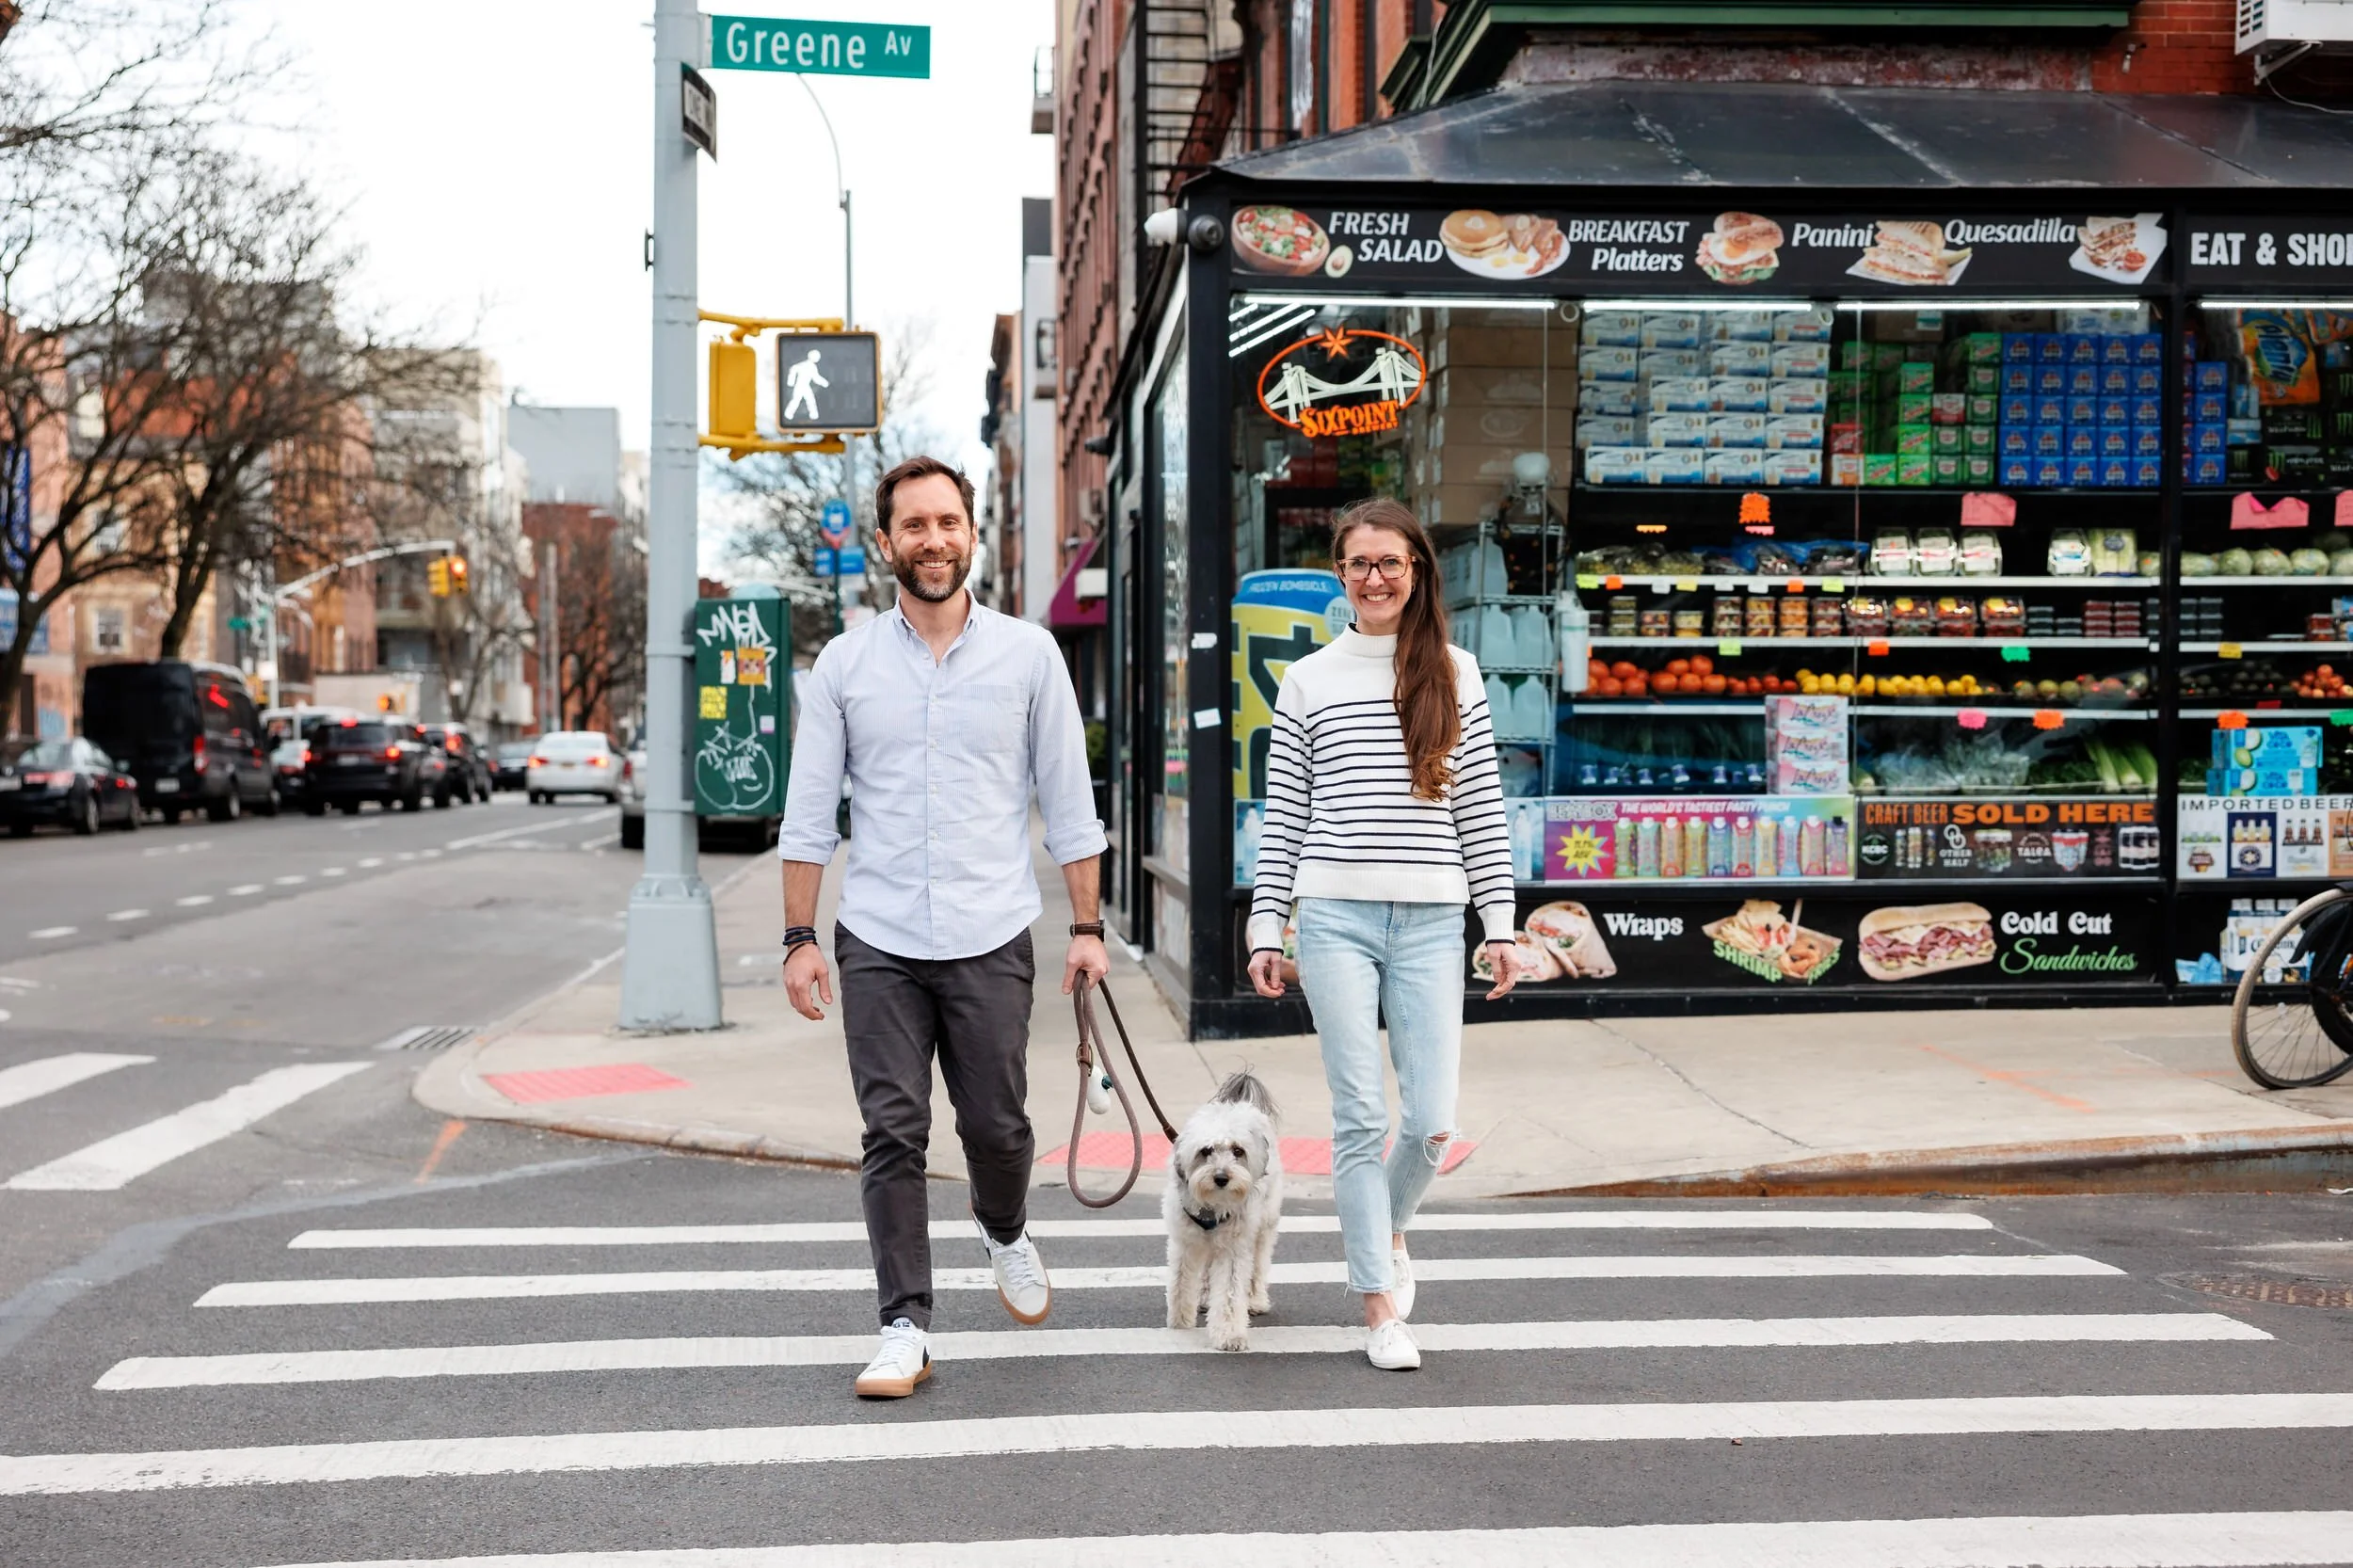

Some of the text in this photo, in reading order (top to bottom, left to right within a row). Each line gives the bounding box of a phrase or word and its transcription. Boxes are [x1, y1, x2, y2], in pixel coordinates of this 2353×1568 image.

[727, 23, 912, 69] Greene Av
[1328, 211, 1411, 236] FRESH
[1567, 219, 1690, 244] BREAKFAST
[1791, 222, 1875, 248] Panini
[1945, 217, 2076, 244] Quesadilla
[1357, 238, 1444, 263] SALAD
[1591, 247, 1685, 272] Platters
[2190, 232, 2246, 266] EAT
[2255, 232, 2277, 266] &
[1299, 398, 1399, 439] SIXPOINT
[1621, 801, 1640, 814] THE
[1865, 803, 2154, 824] CRAFT BEER SOLD HERE
[2181, 798, 2295, 810] IMPORTED
[1939, 848, 1973, 858] OTHER
[1943, 857, 1969, 867] HALF
[1602, 912, 1684, 941] Wraps
[2000, 911, 2113, 935] Cold Cut
[1712, 939, 1784, 984] SHRIMP
[1999, 937, 2138, 975] Sandwiches
